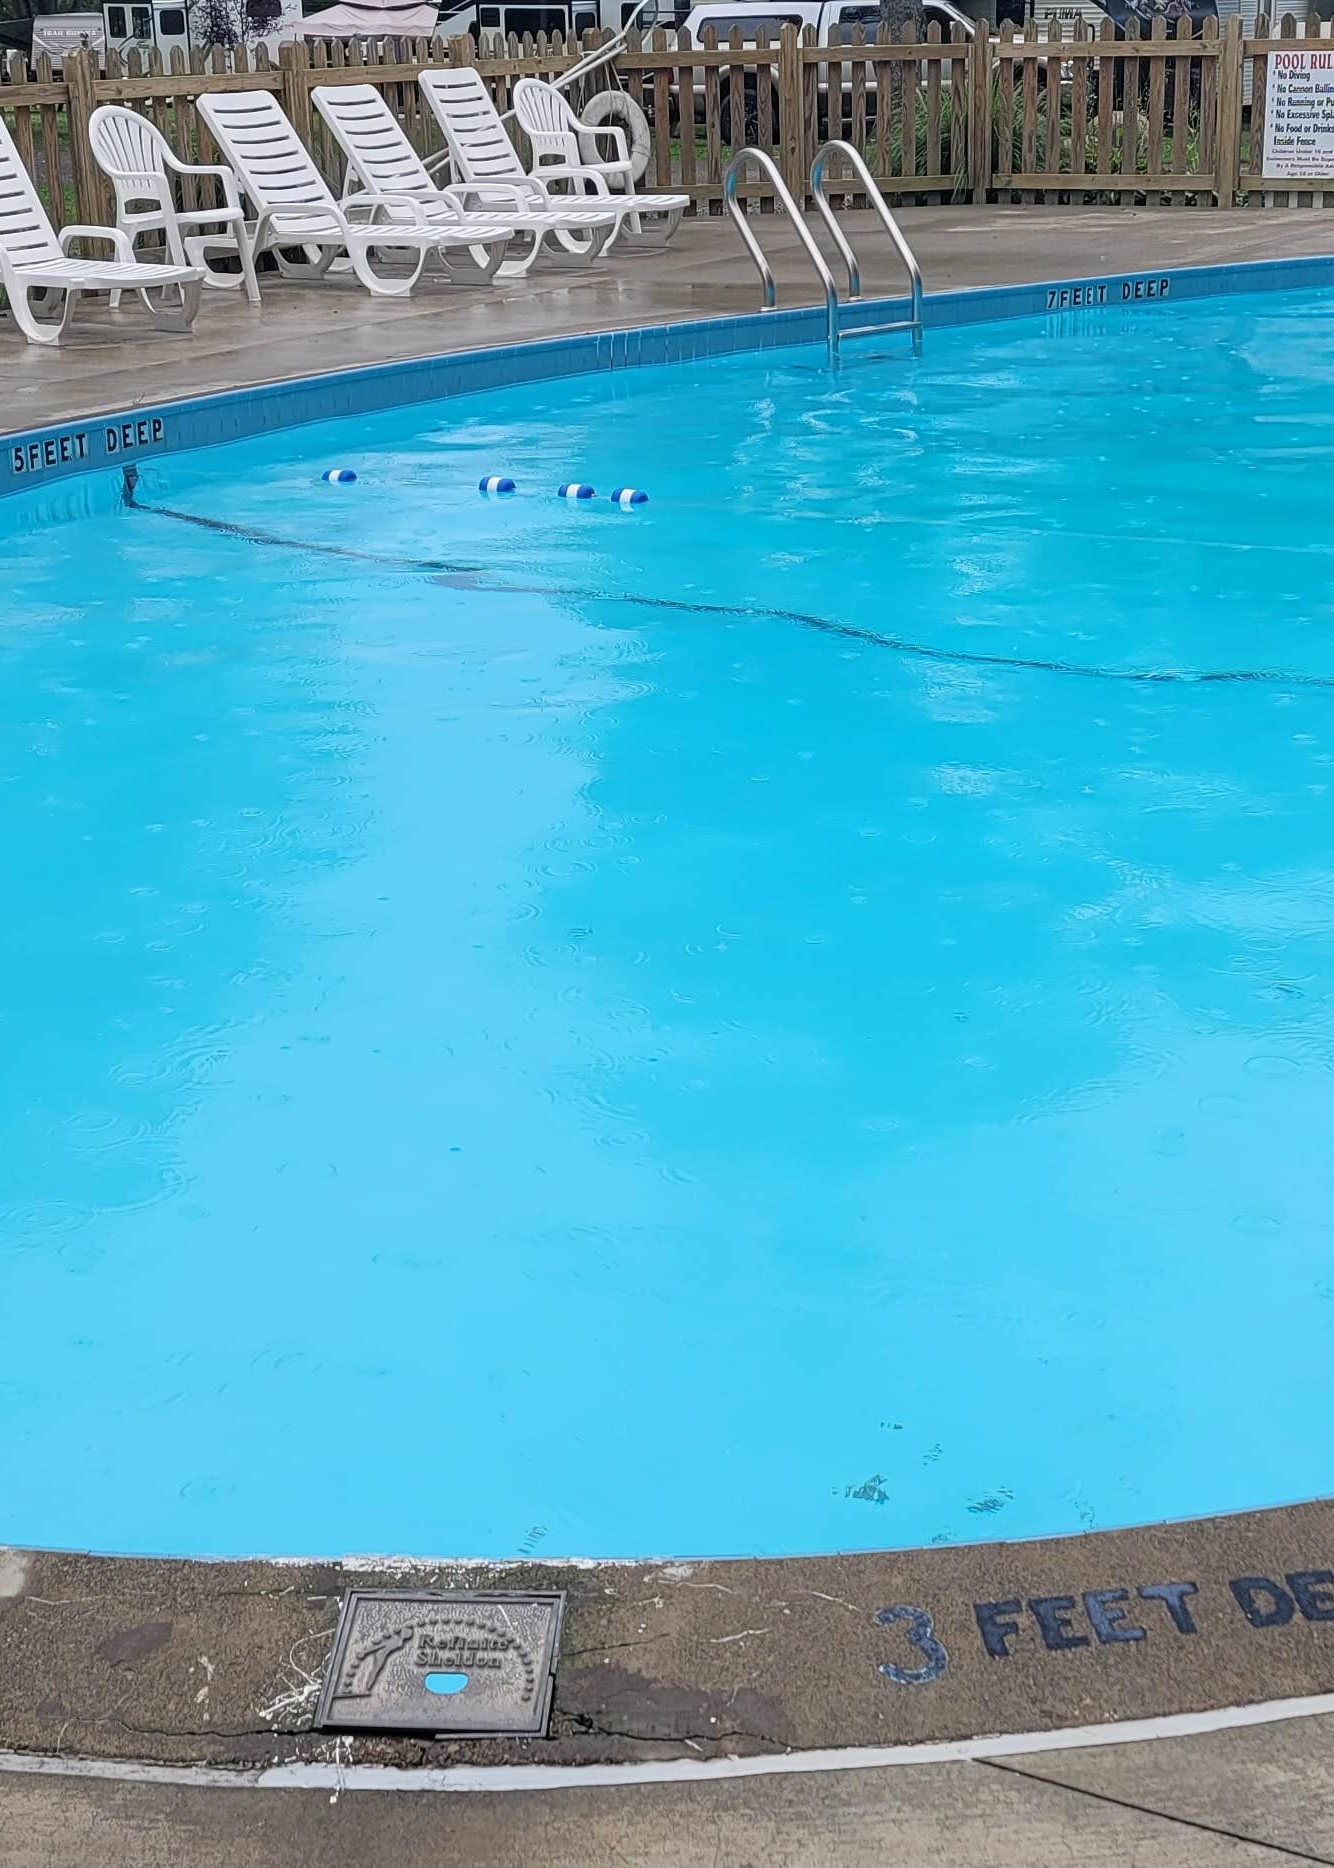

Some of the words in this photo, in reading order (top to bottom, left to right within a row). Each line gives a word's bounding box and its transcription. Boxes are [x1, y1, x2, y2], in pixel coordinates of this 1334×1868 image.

[1274, 54, 1307, 69] POOL
[1277, 70, 1287, 80] No
[1289, 70, 1311, 81] Diving
[1276, 84, 1286, 93] No
[1288, 84, 1313, 93] Cannon
[1276, 97, 1286, 106] No
[1288, 97, 1315, 109] Running
[1275, 110, 1285, 119] No
[1287, 110, 1320, 119] Excessive
[1275, 123, 1284, 133] No
[1286, 123, 1302, 133] Food
[1304, 125, 1311, 133] or
[1313, 123, 1334, 133] Drinks
[1273, 136, 1294, 145] Inside
[1296, 136, 1316, 145] Fence
[1122, 279, 1169, 300] DEEP
[106, 418, 164, 452] DEEP
[874, 1604, 949, 1685] 3
[974, 1581, 1200, 1659] FEET
[415, 1650, 503, 1670] Sheldon
